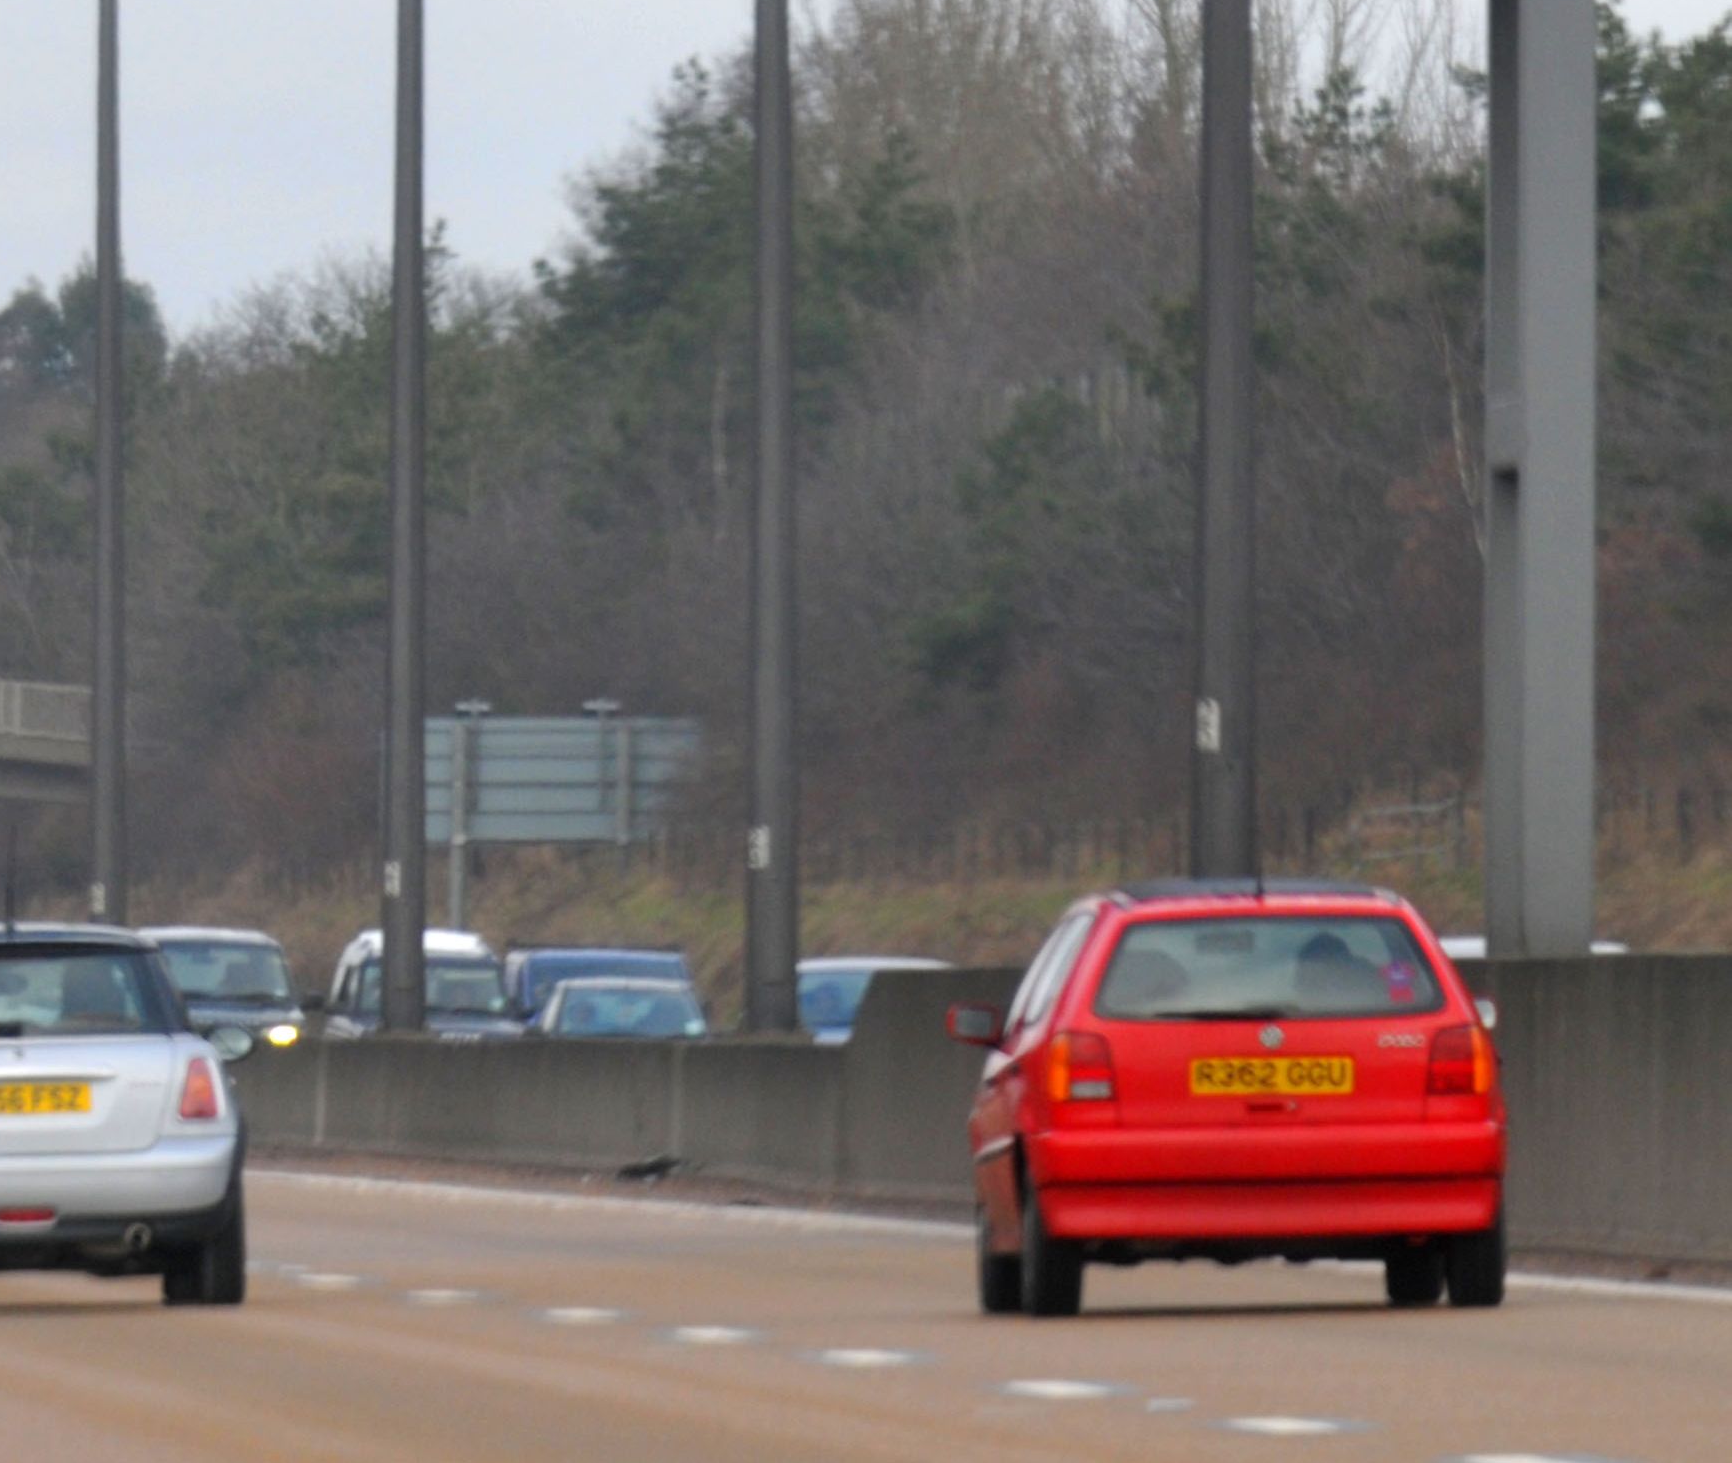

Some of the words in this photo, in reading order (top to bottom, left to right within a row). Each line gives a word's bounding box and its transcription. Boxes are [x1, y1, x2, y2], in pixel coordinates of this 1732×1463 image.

[1196, 1061, 1277, 1088] R362
[1287, 1061, 1346, 1087] GGU
[33, 1085, 82, 1111] FSZ
